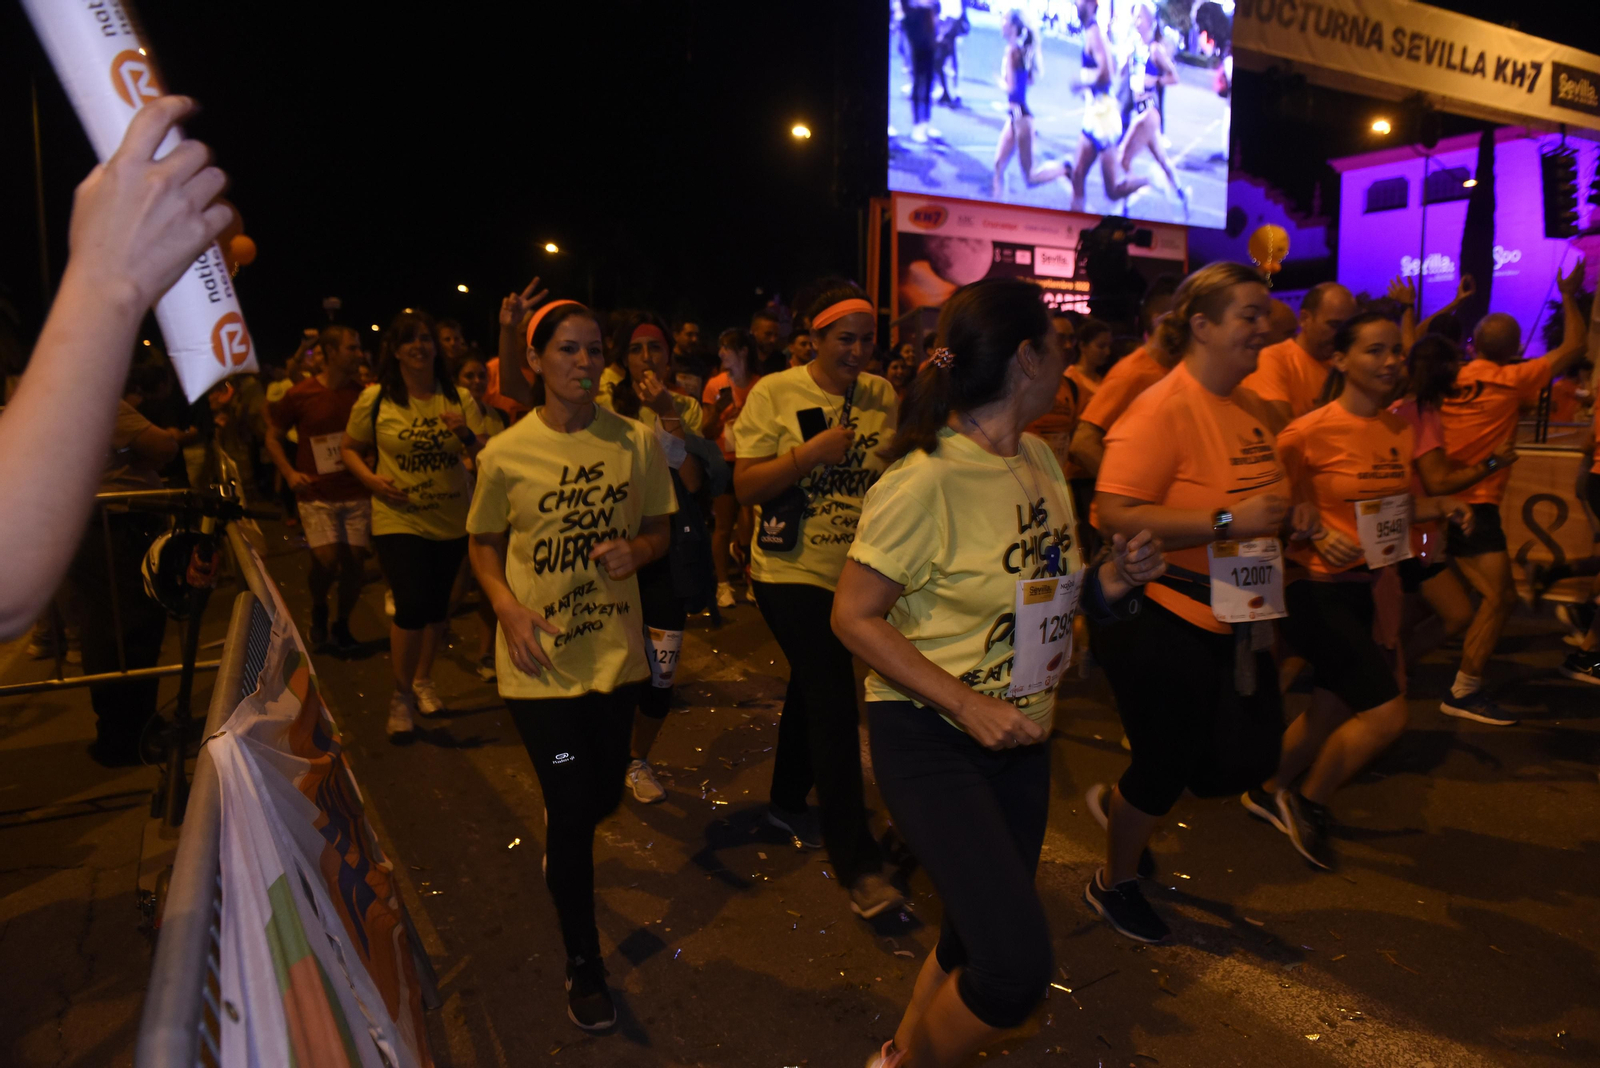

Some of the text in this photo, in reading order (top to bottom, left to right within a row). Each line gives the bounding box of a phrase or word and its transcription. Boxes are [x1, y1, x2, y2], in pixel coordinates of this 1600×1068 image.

[1235, 0, 1546, 95] NOCTURNA SEVILLA KH7
[398, 429, 453, 441] CHICAS
[412, 417, 438, 428] LAS
[559, 461, 605, 486] LAS
[538, 481, 629, 513] CHICAS
[558, 506, 615, 534] SON
[1016, 497, 1048, 534] LAS
[760, 534, 784, 545] adidas
[1231, 565, 1273, 587] 12007
[543, 580, 598, 619] BEATRIZ
[554, 619, 604, 648] CHARO
